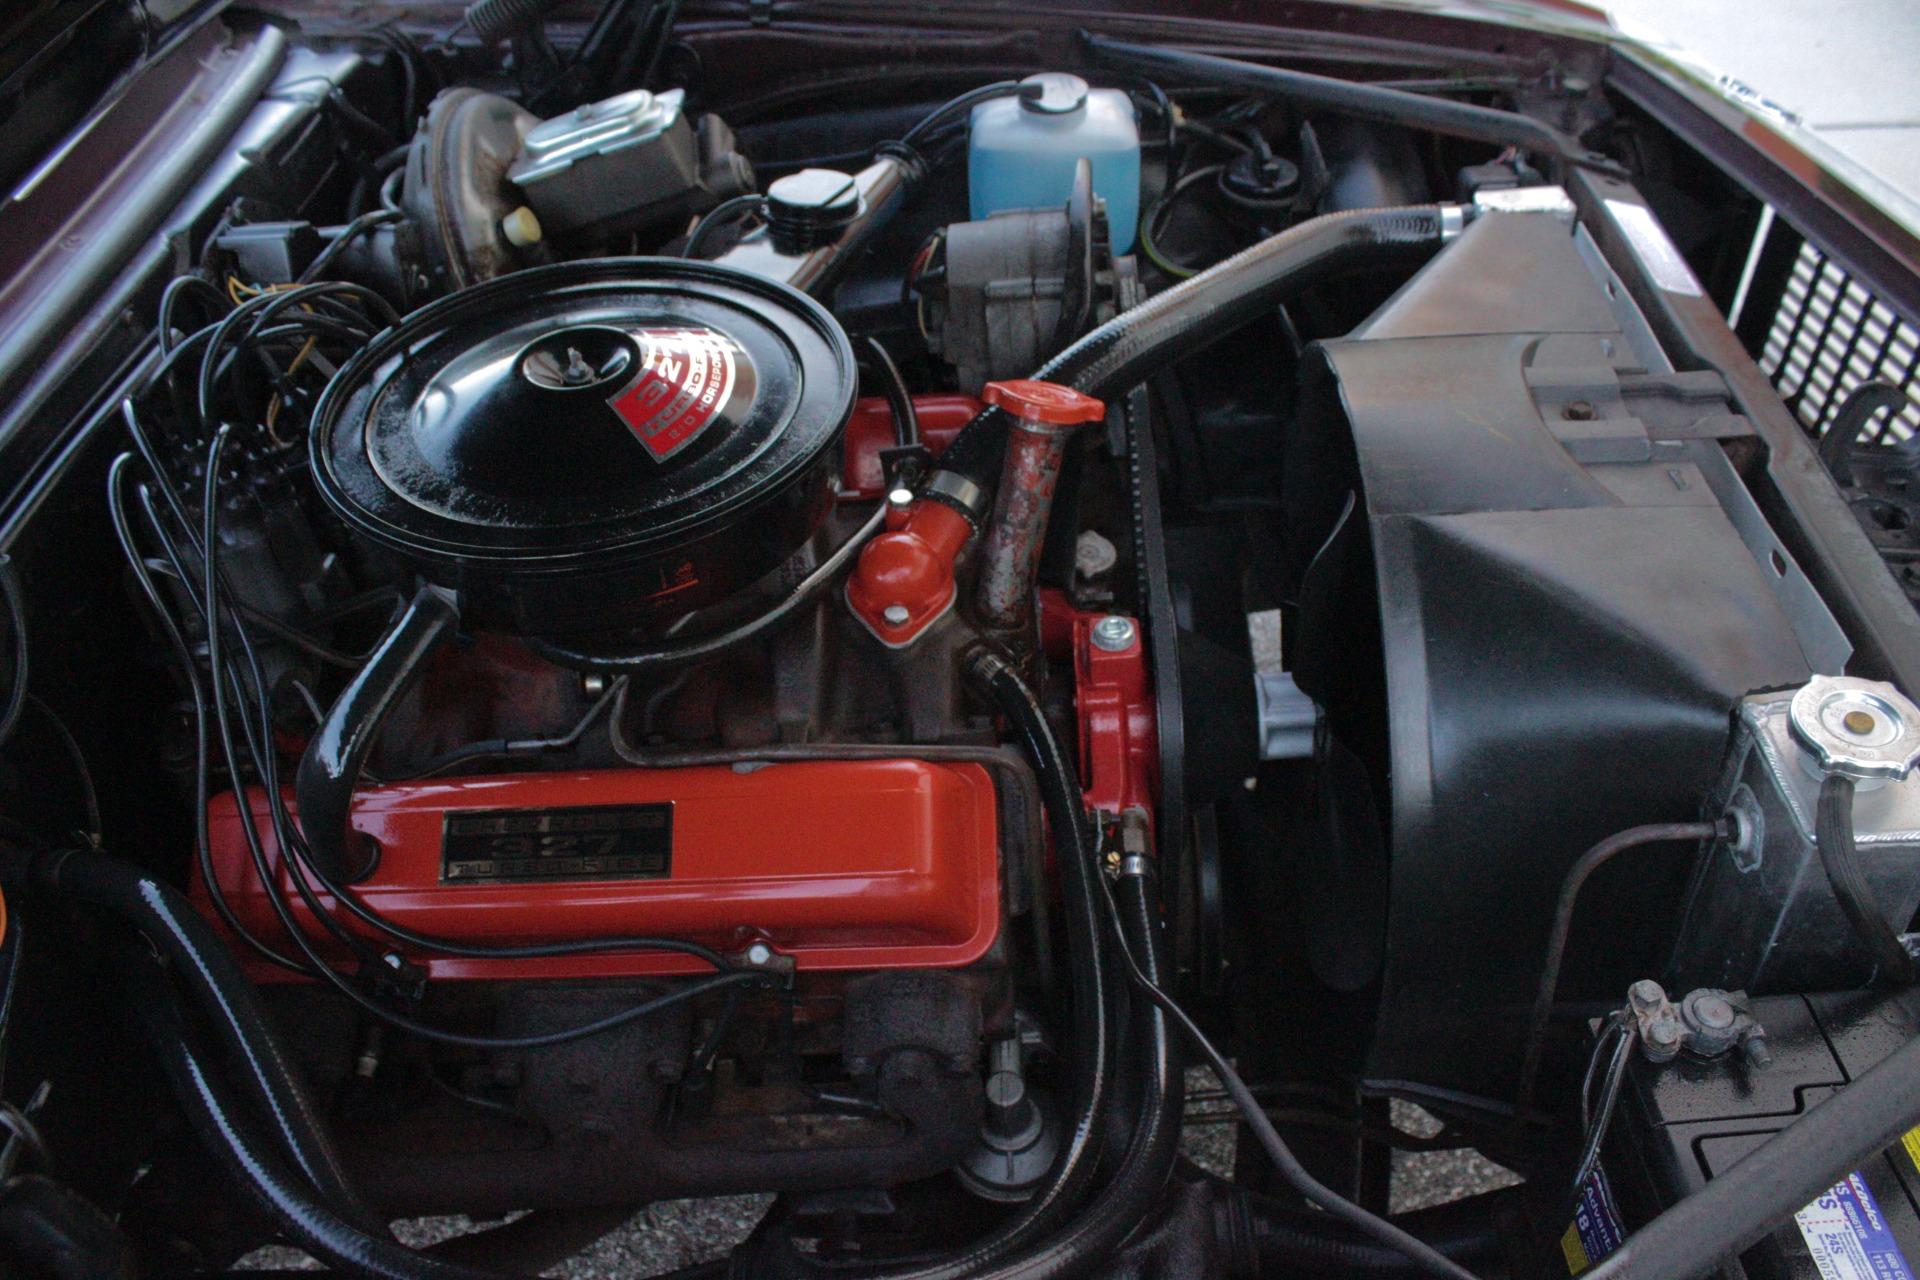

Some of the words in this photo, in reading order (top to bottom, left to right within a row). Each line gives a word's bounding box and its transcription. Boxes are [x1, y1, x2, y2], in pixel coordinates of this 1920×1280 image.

[491, 833, 621, 858] 327
[1825, 1232, 1843, 1254] 24S
[1872, 1254, 1886, 1271] 113
